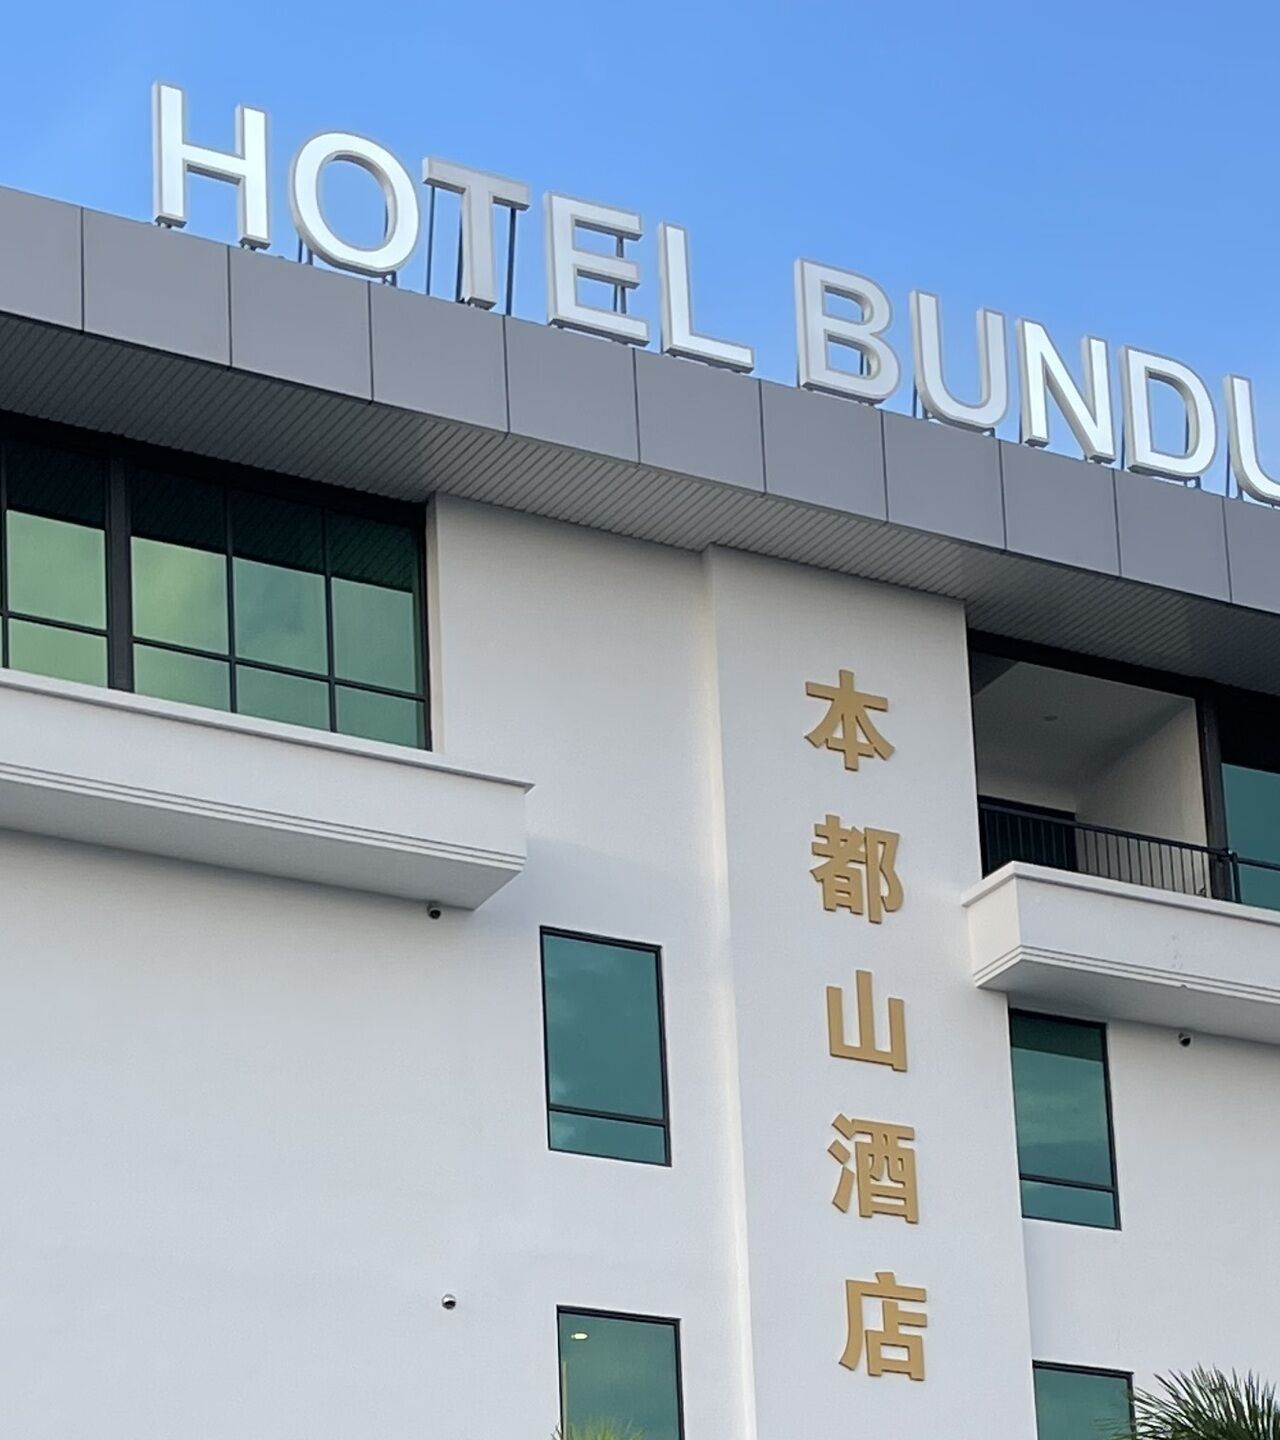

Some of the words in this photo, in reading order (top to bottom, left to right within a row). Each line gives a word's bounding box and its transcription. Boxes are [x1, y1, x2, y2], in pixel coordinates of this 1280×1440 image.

[151, 80, 755, 374] HOTEL
[803, 668, 929, 1383] 本都山酒店
